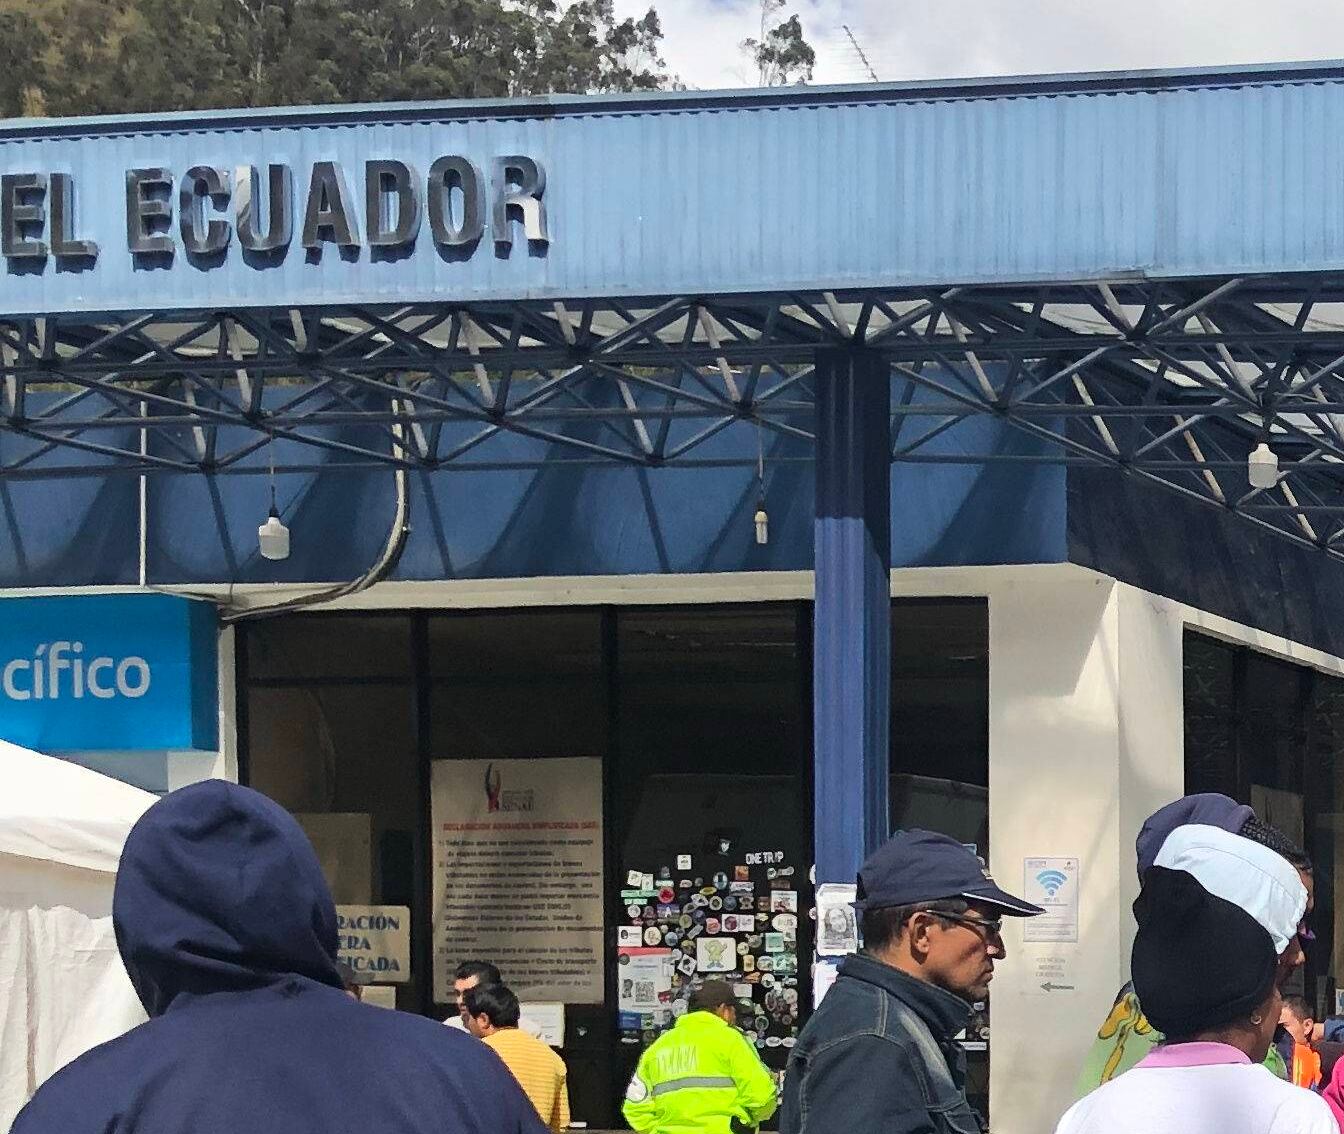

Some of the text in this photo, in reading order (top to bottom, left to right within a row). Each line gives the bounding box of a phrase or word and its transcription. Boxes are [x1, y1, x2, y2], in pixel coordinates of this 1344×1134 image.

[2, 155, 549, 257] EL ECUADOR
[3, 641, 151, 700] cífico
